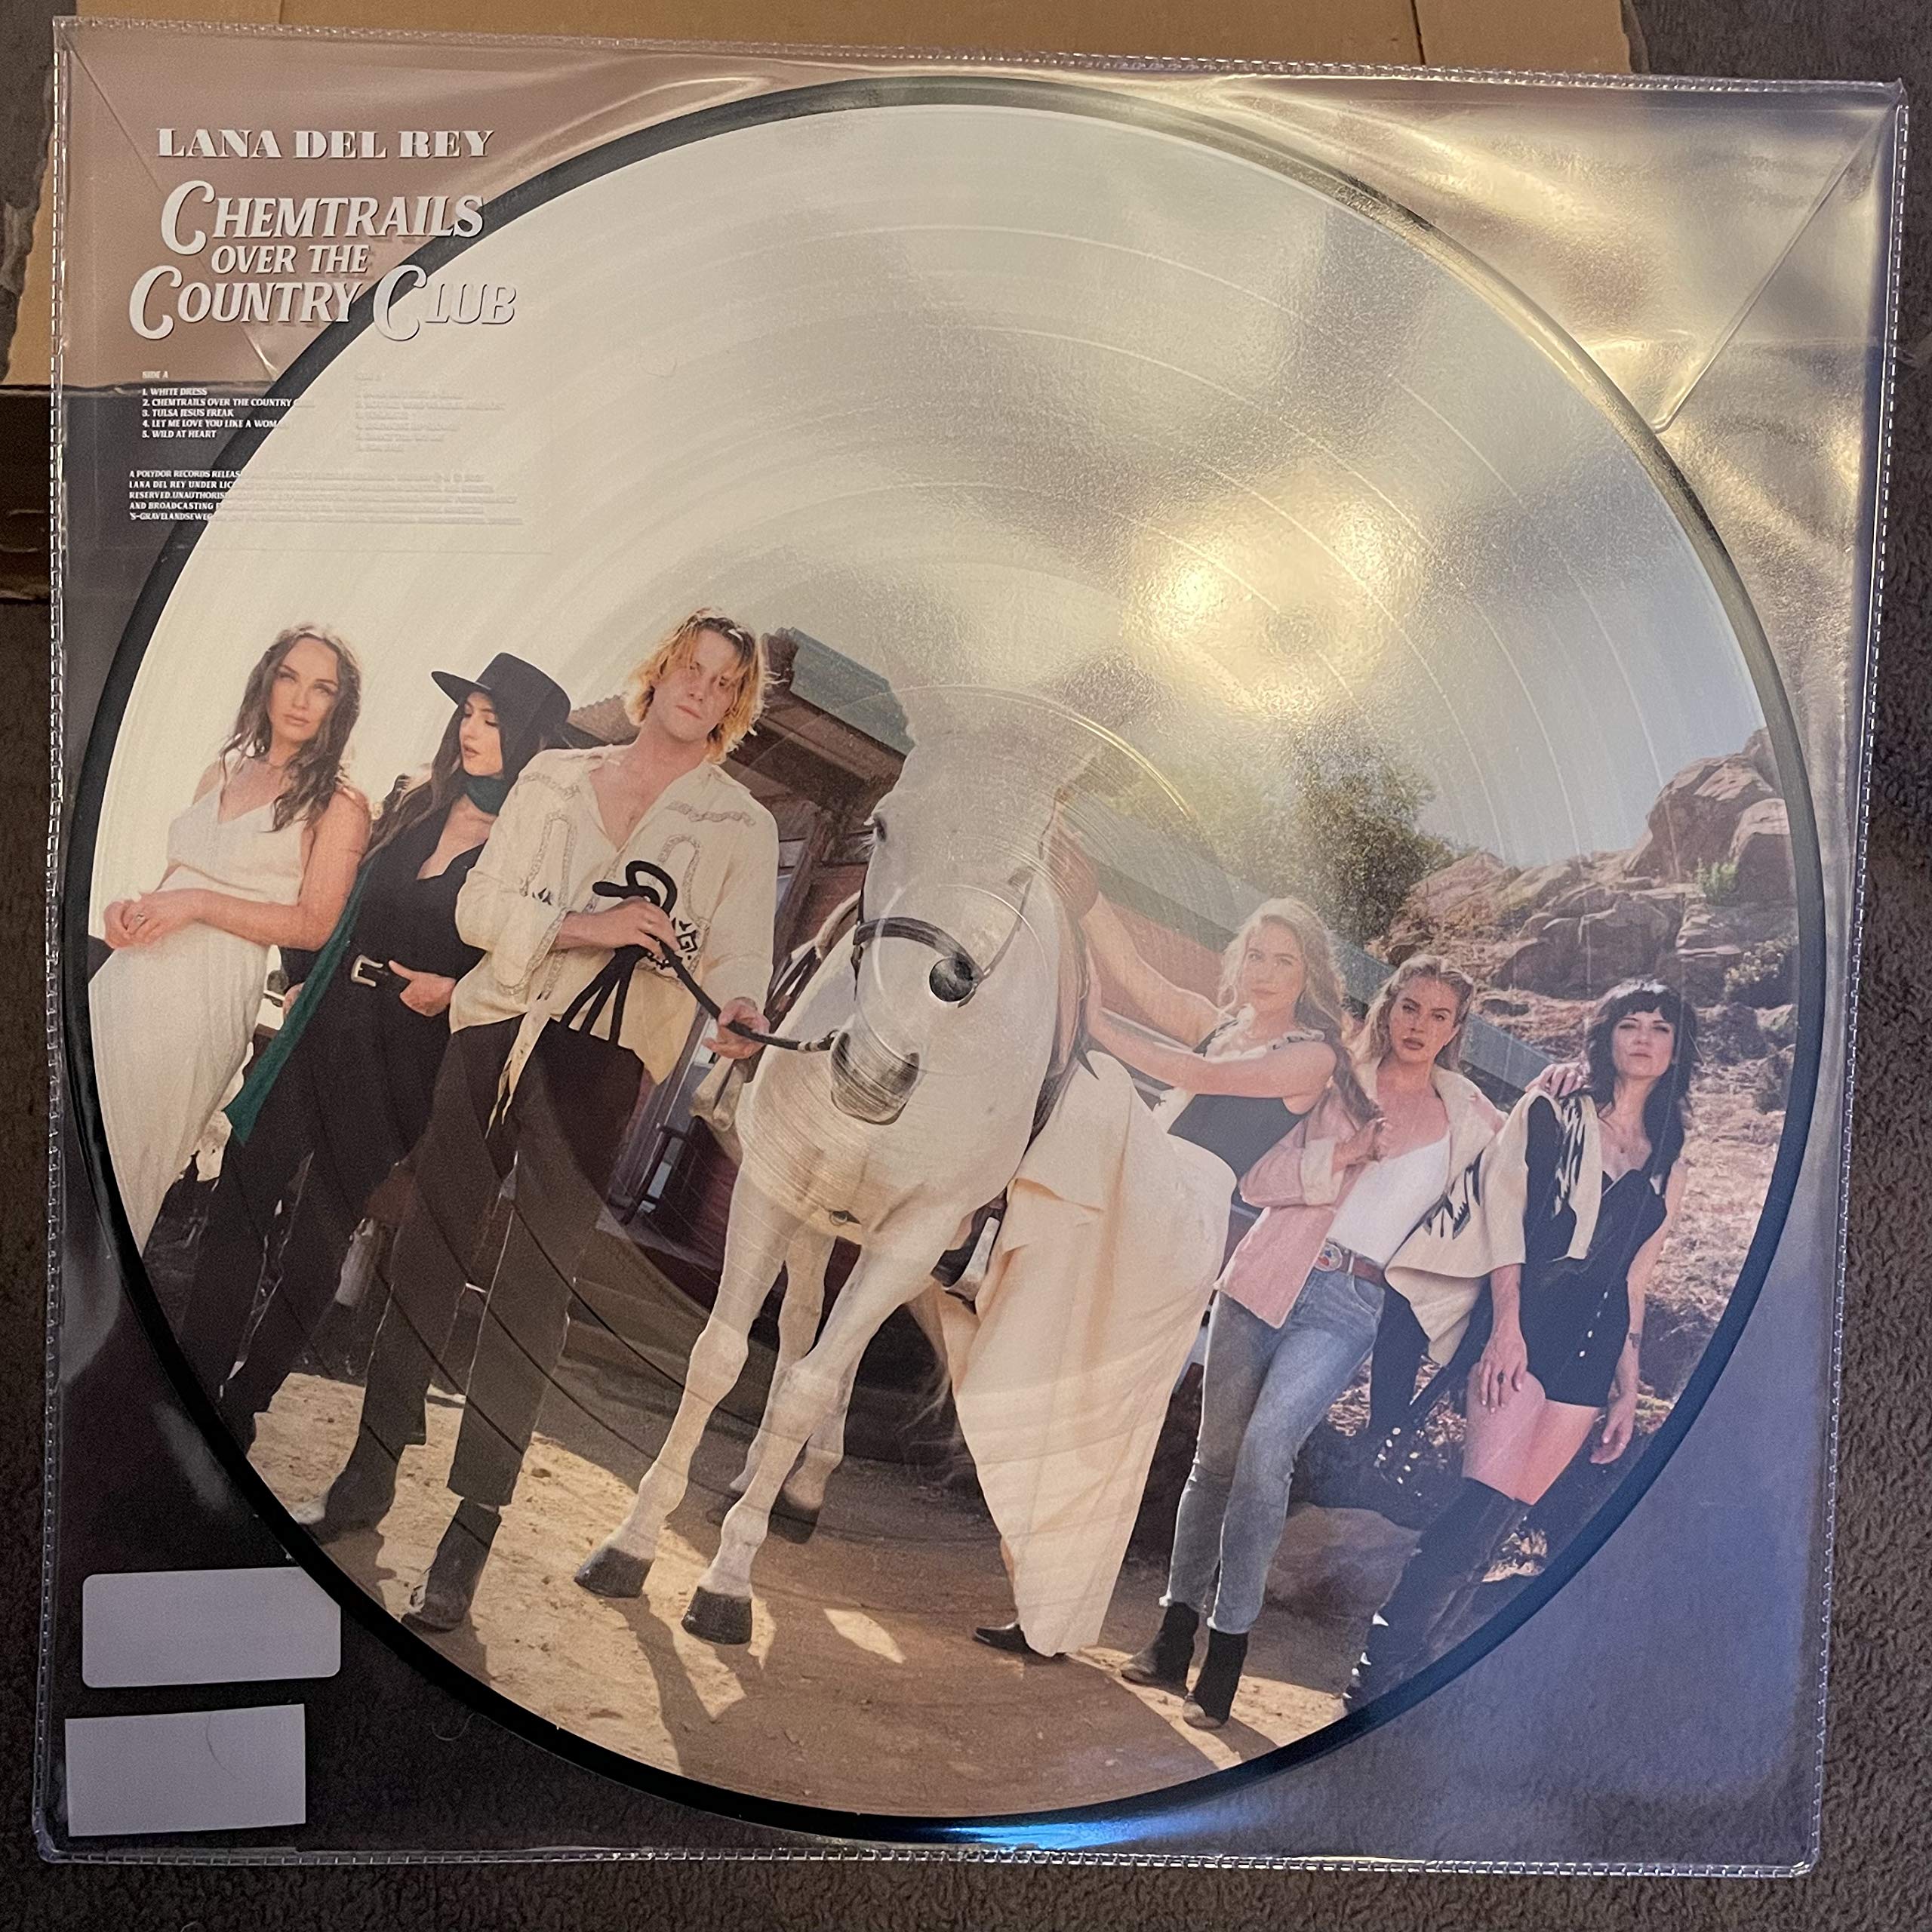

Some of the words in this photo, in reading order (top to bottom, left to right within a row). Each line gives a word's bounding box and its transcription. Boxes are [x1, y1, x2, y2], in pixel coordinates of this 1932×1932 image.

[157, 128, 282, 158] LANA
[294, 130, 388, 159] DEL
[398, 130, 494, 158] REY
[161, 180, 484, 255] CHEMTRAILS
[211, 245, 297, 275] OVER
[309, 245, 370, 274] THE
[129, 265, 364, 340] COUNTRY
[373, 264, 518, 342] CLUB
[162, 371, 169, 379] A
[150, 387, 178, 396] WHITE
[180, 387, 208, 396] DRESS
[142, 398, 150, 407] 2.
[152, 398, 205, 407] CHEMTRAILS
[207, 398, 230, 407] OVER
[232, 398, 249, 407] THE
[251, 398, 292, 408] COUNTRY
[142, 409, 150, 417] 3.
[152, 408, 179, 417] TULSA
[180, 408, 205, 417] JESUS
[207, 408, 234, 417] FREAK
[142, 420, 150, 428] 4.
[152, 420, 166, 428] LET
[168, 420, 180, 428] ME
[182, 420, 203, 428] LOVE
[205, 420, 223, 428] YOU
[224, 420, 244, 428] LIKE
[245, 420, 252, 428] A
[254, 420, 278, 428] WOM
[142, 430, 150, 438] 5.
[152, 430, 174, 438] WILD
[176, 430, 186, 438] AT
[188, 430, 217, 438] HEART
[129, 481, 151, 489] LANA
[152, 481, 168, 489] DEL
[170, 481, 186, 489] REY
[189, 481, 217, 489] UNDER
[129, 502, 147, 510] AND
[148, 502, 214, 510] BROADCASTING
